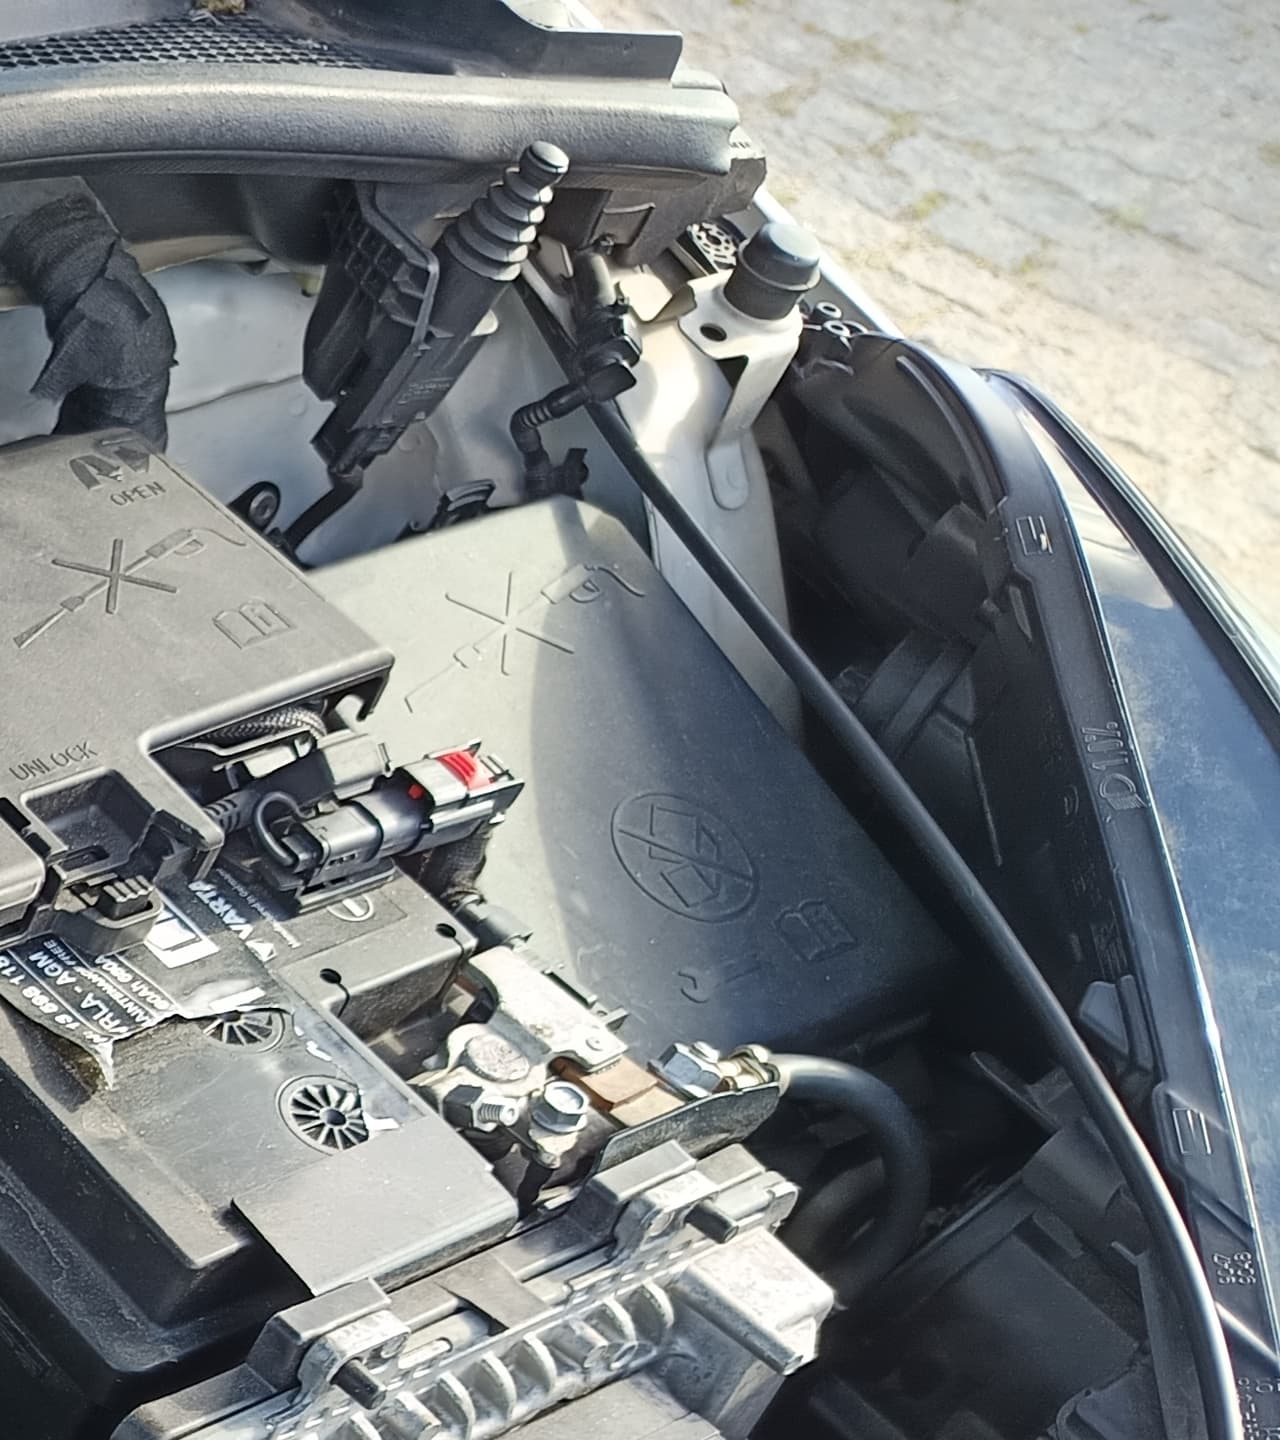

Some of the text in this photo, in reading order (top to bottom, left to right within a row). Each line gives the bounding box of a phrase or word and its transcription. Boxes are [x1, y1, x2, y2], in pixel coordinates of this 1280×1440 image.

[109, 480, 166, 509] OPEN
[10, 740, 99, 783] UNLOCK
[188, 881, 254, 940] VARTA
[28, 951, 77, 987] AGM
